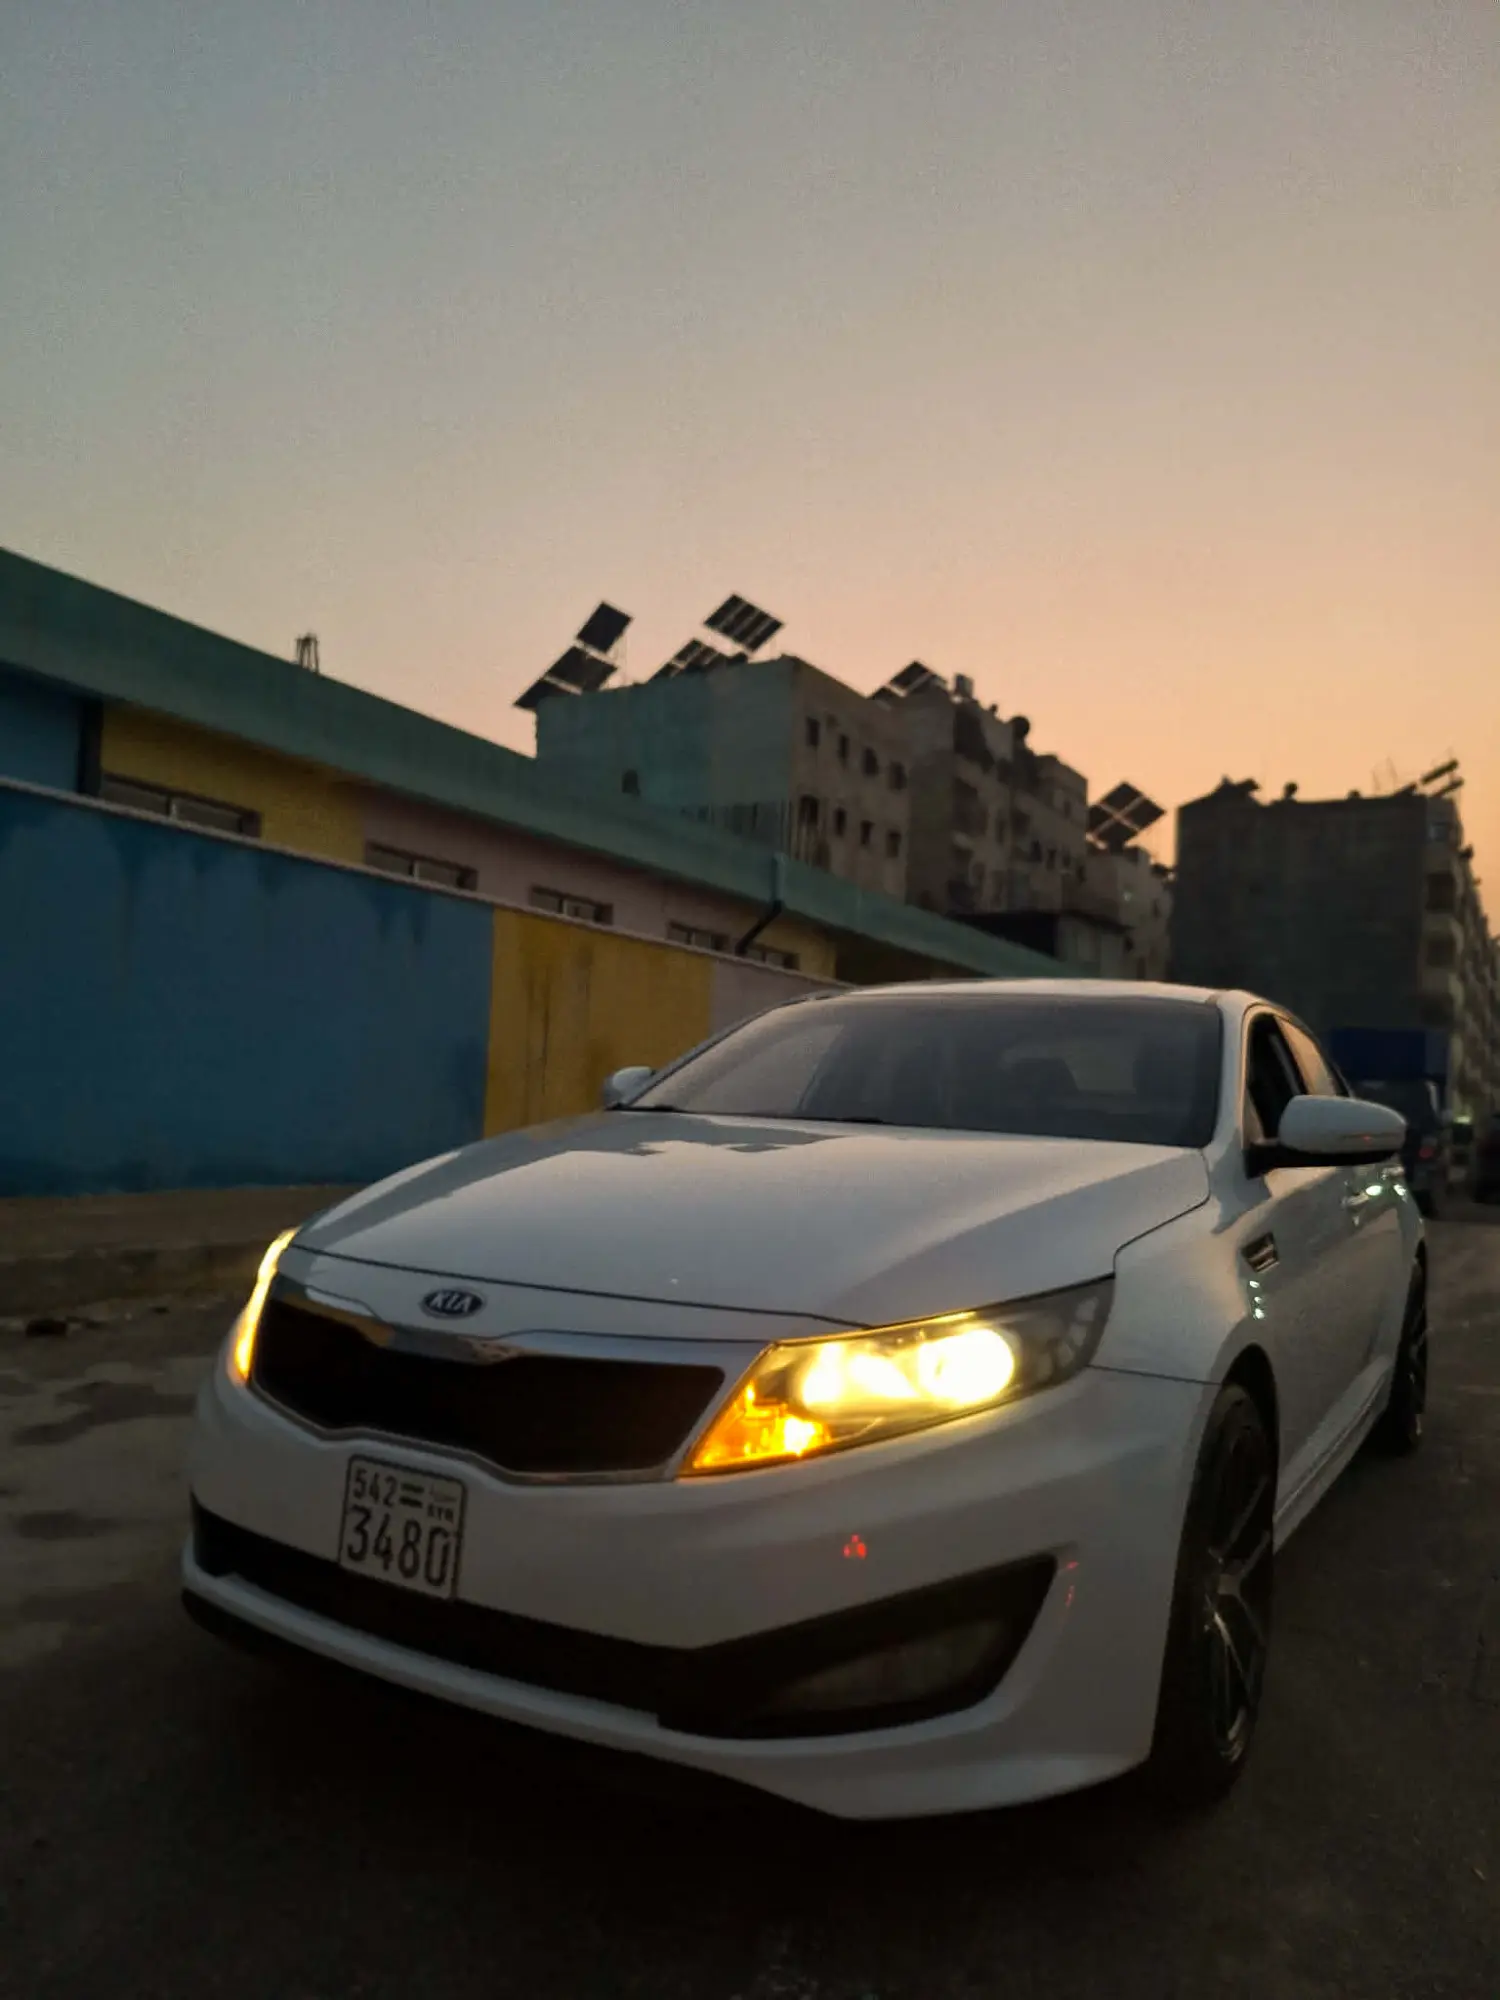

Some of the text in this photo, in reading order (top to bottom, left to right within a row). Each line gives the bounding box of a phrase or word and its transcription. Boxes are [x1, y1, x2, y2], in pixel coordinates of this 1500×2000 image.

[429, 1291, 473, 1312] KIA
[353, 1468, 397, 1508] 542
[348, 1504, 450, 1587] 3480
